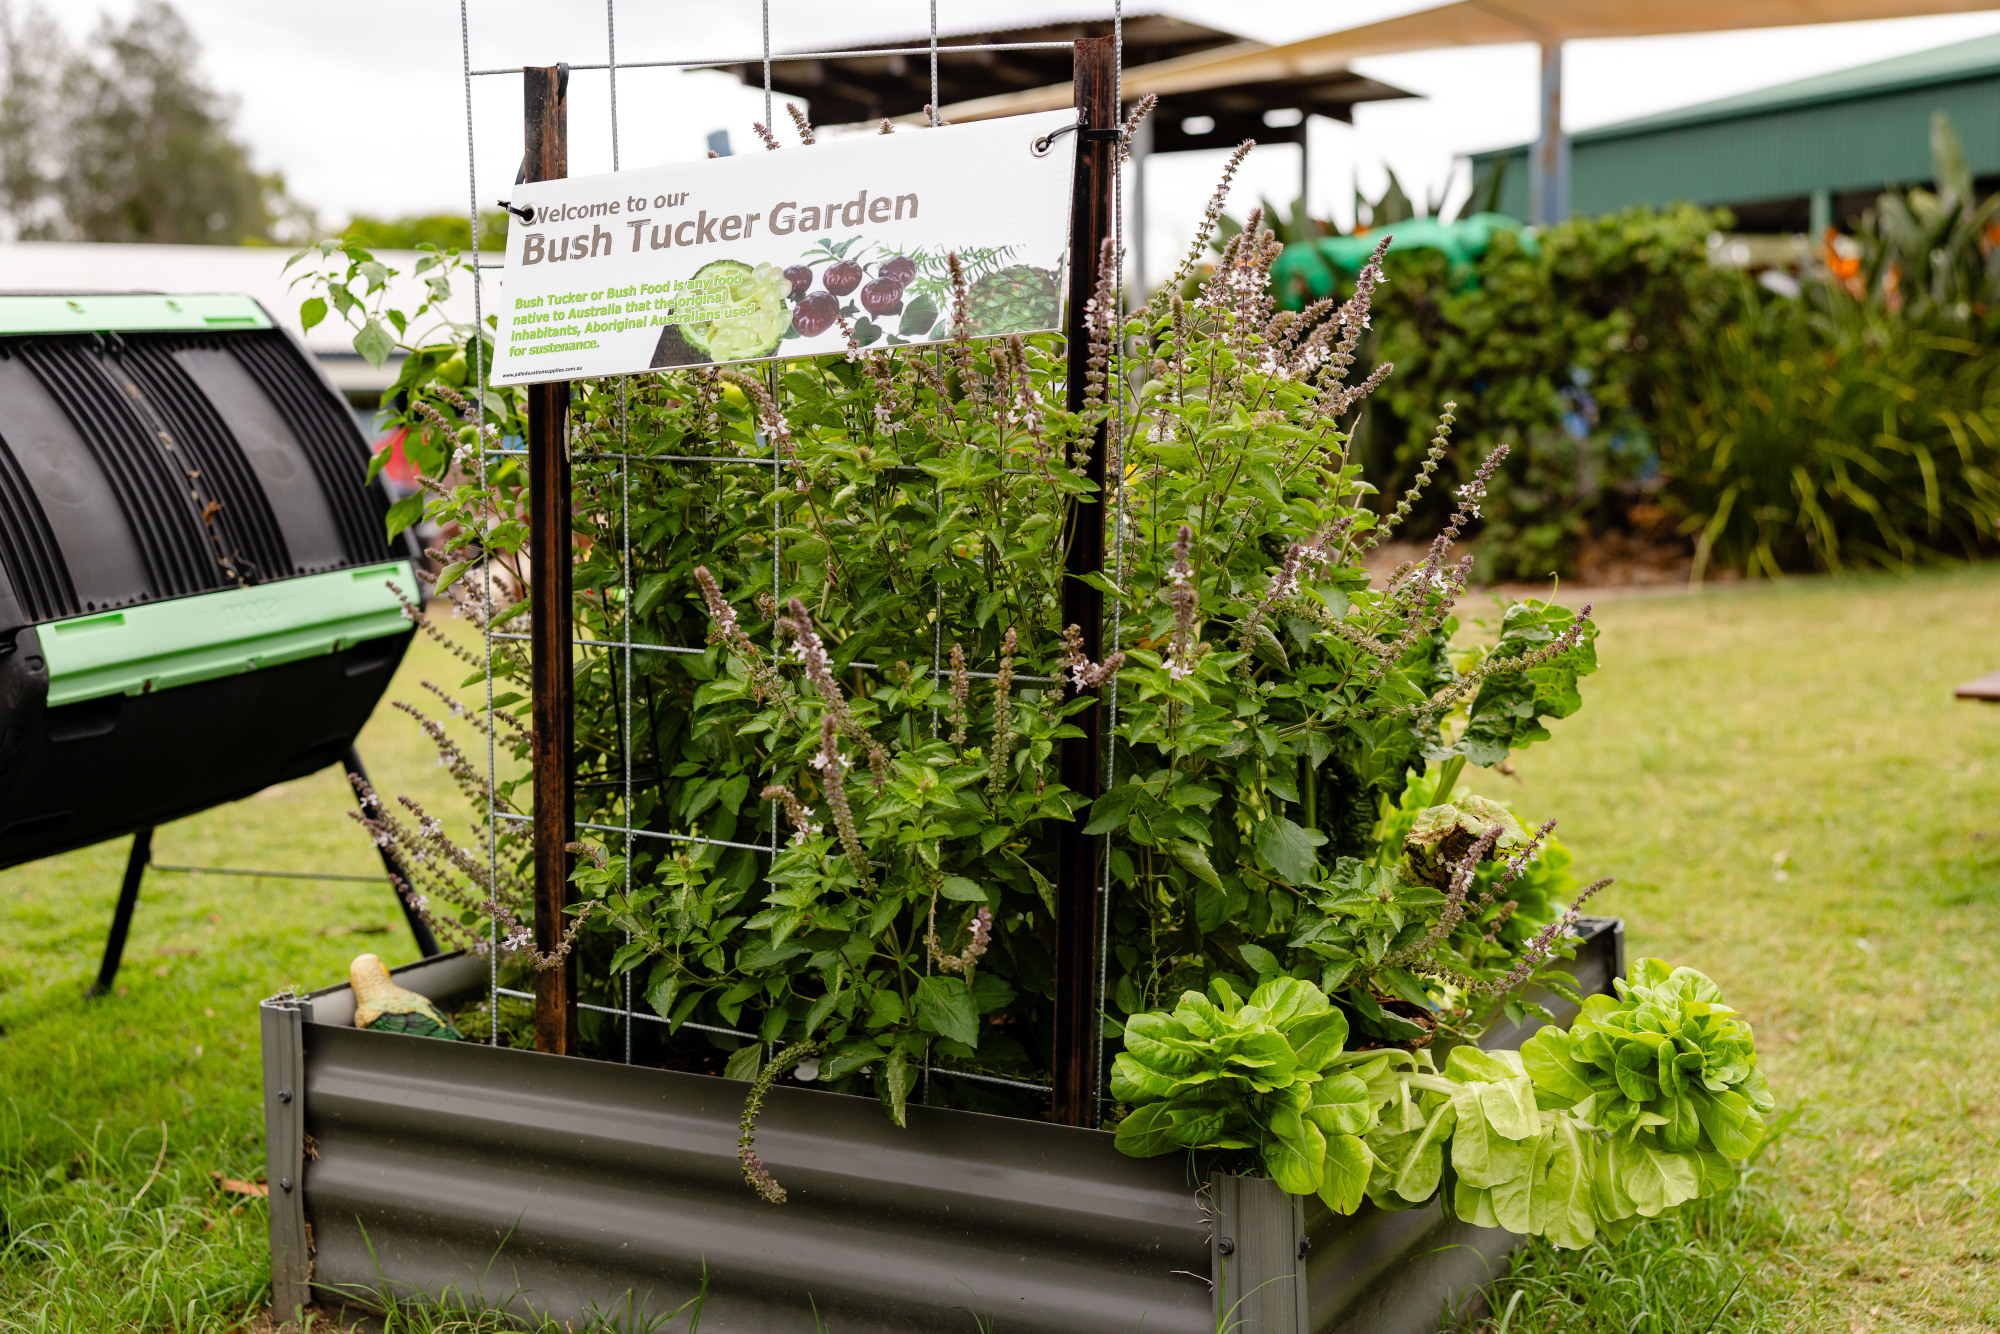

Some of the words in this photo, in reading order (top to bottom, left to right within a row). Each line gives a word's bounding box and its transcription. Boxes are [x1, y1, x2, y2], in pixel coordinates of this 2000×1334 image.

[627, 195, 648, 212] to
[654, 192, 690, 208] our
[522, 224, 613, 266] Bush
[627, 210, 760, 253] Tucker
[769, 190, 919, 236] Garden
[513, 312, 549, 325] native
[553, 310, 565, 321] to
[568, 303, 622, 319] Australia
[625, 300, 651, 313] that
[654, 297, 675, 309] the
[678, 290, 726, 308] original
[515, 296, 544, 310] Bush
[547, 291, 588, 306] Tucker
[590, 290, 604, 301] or
[606, 285, 637, 299] Bush
[640, 281, 670, 295] Food
[673, 280, 684, 291] is
[686, 277, 711, 290] any
[713, 272, 743, 286] food
[511, 324, 581, 341] inhabitants,
[584, 316, 647, 333] Aboriginal
[650, 309, 721, 327] Australians
[724, 303, 755, 318] used
[509, 345, 527, 357] for
[528, 339, 600, 355] sustenance.
